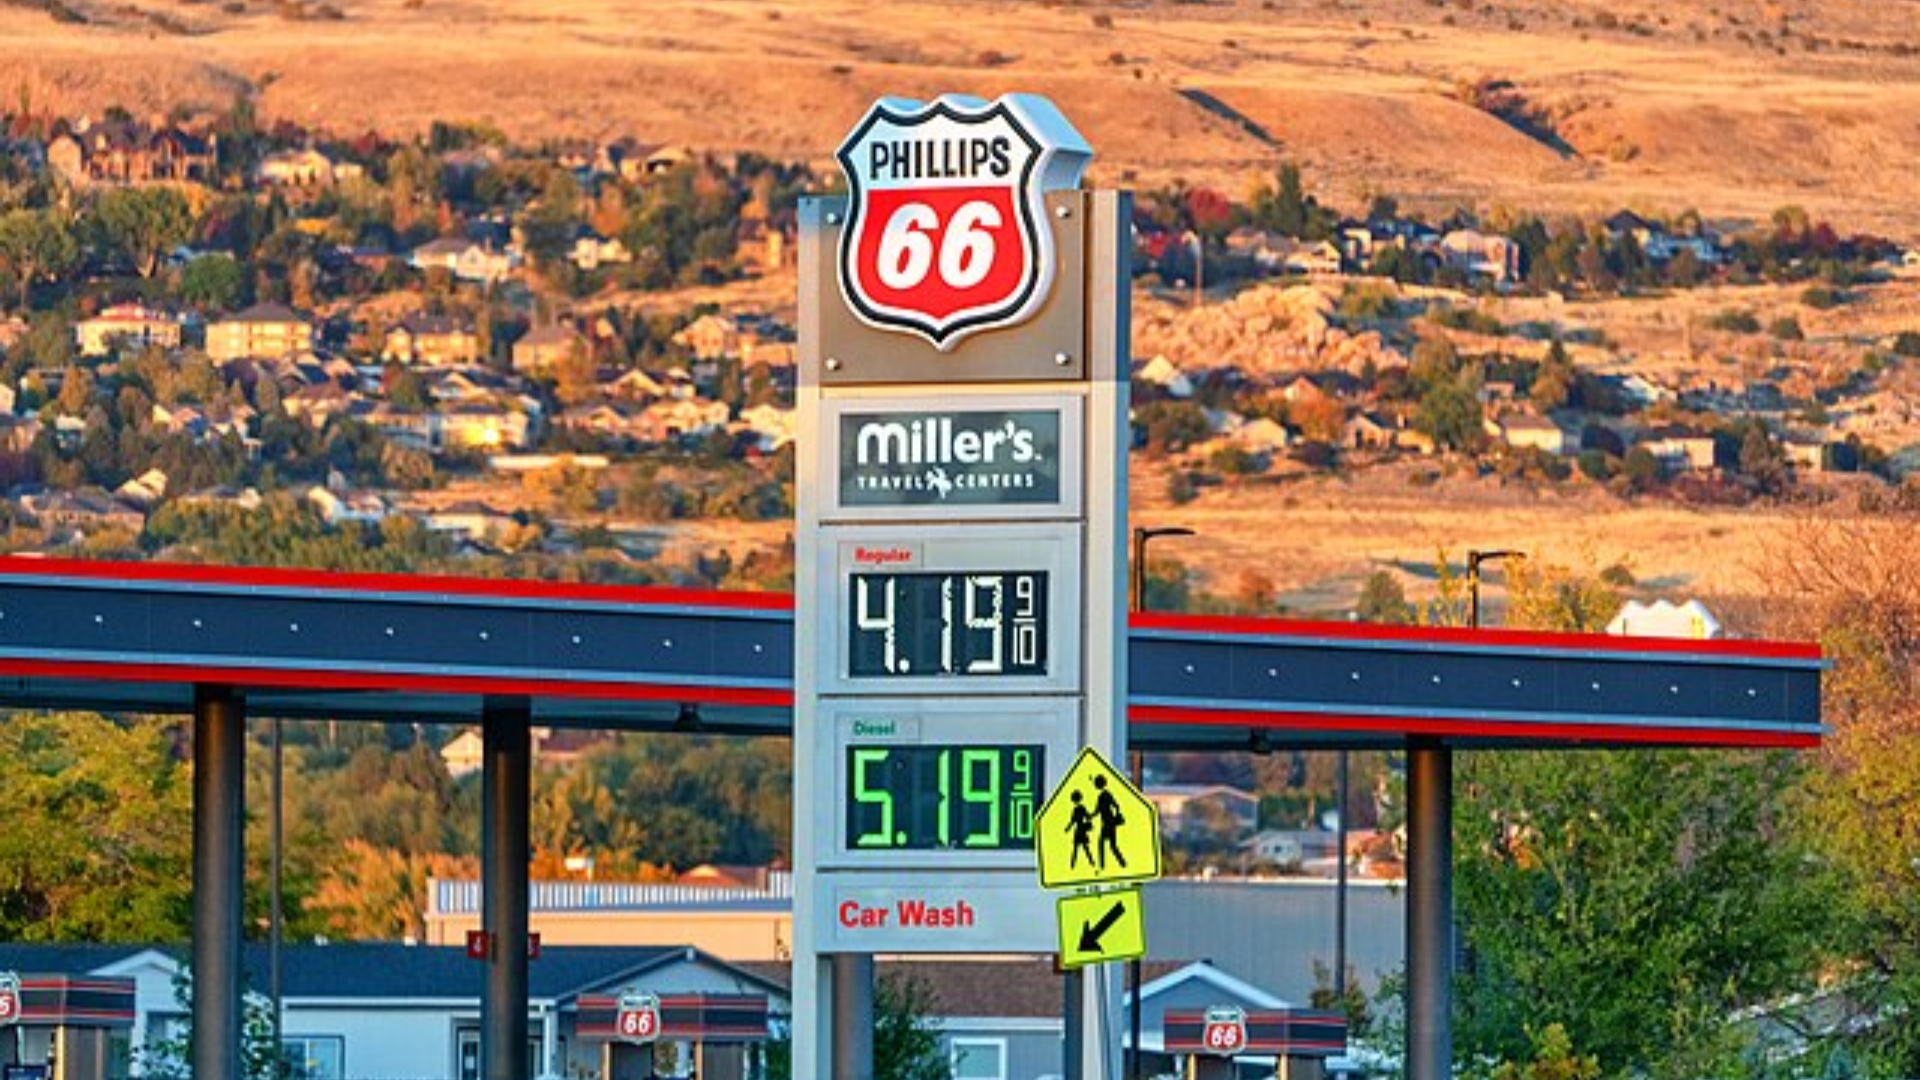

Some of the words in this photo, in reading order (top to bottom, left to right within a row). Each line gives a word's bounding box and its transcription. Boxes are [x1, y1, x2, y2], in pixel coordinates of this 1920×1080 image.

[870, 138, 1011, 179] PHILLIPS
[877, 200, 1002, 289] 66
[858, 475, 922, 488] TRAVEL
[956, 473, 1034, 487] CENTERS
[855, 548, 911, 563] Regular
[857, 576, 1002, 673] 4.19
[854, 721, 894, 735] Diesel
[854, 750, 1000, 847] 5.19
[840, 900, 889, 928] Car
[897, 900, 974, 928] Wash
[624, 1012, 651, 1034] 66
[1211, 1025, 1237, 1046] 66
